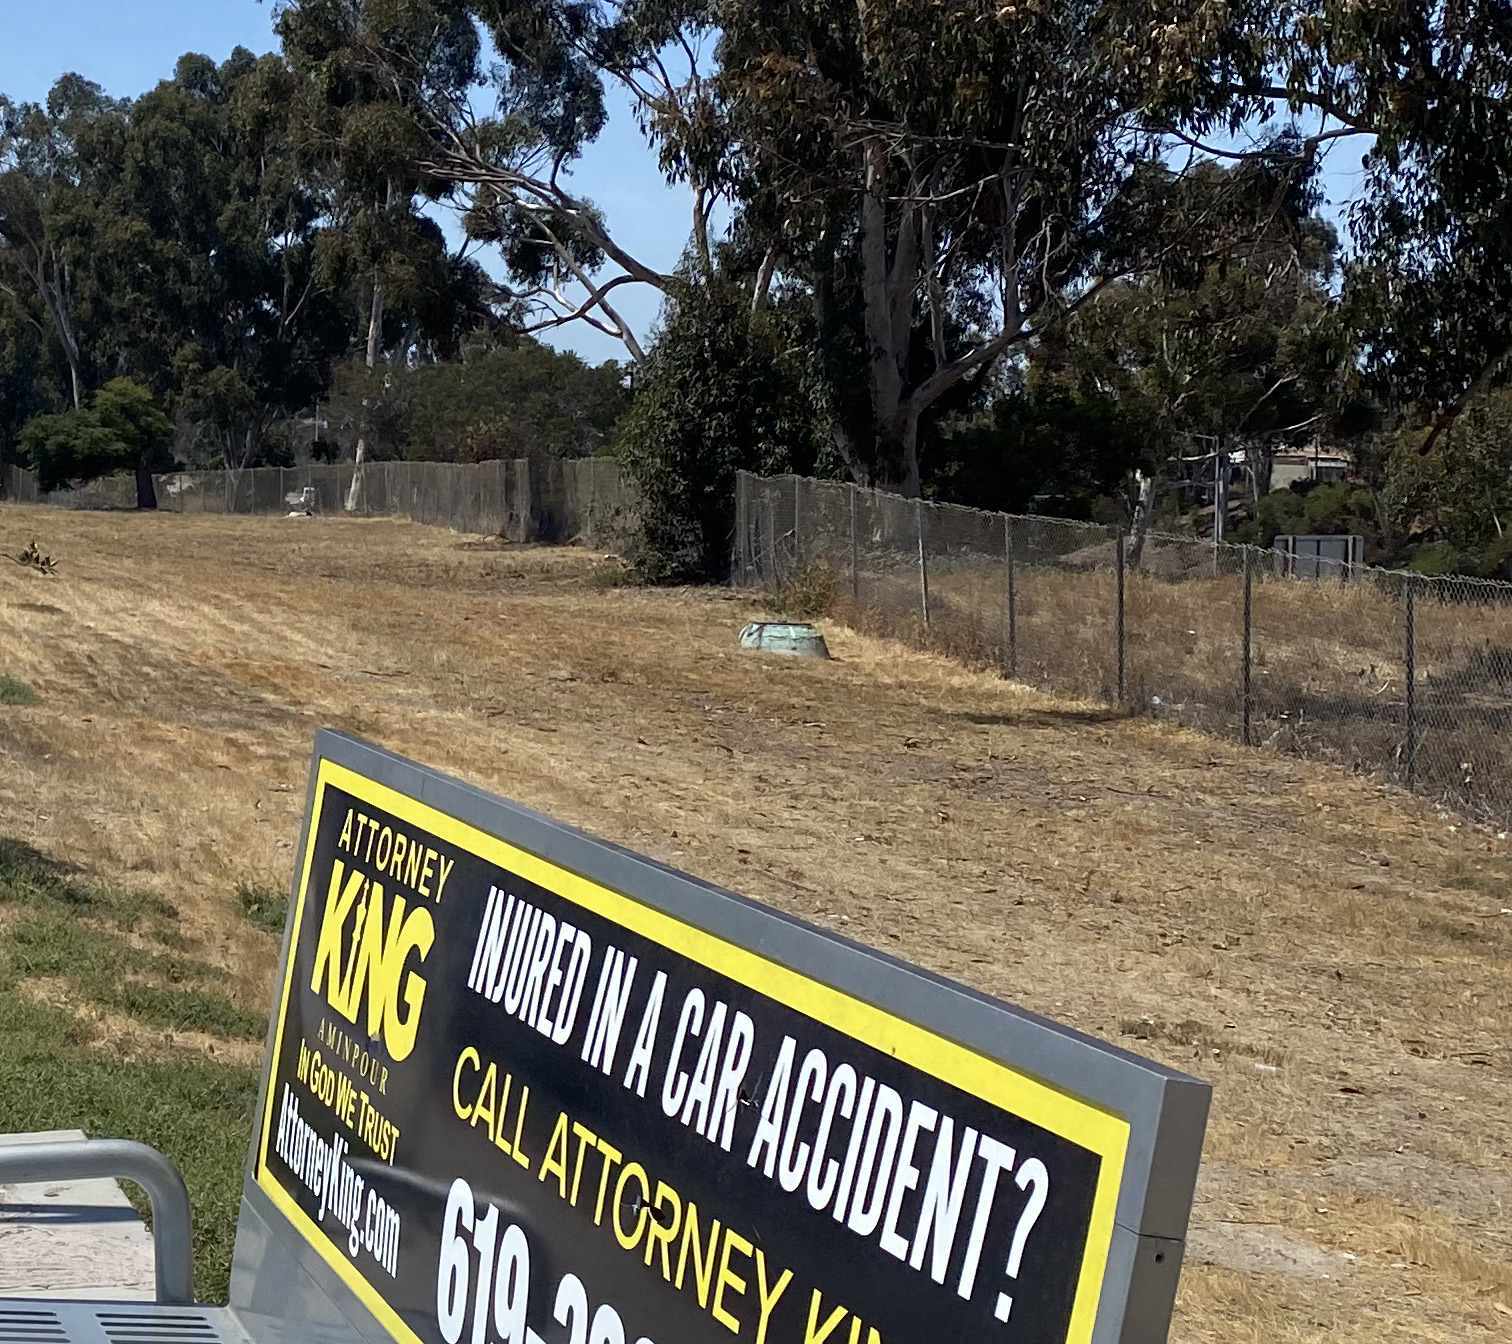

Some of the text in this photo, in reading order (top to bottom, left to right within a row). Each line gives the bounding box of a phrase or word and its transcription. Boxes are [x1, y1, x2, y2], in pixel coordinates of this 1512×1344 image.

[338, 808, 455, 904] ATTORNEY
[310, 858, 435, 1062] KING
[317, 1016, 389, 1096] AMINPOUR
[452, 1046, 530, 1170] CALL
[467, 885, 1049, 1323] INJURED IN A CAR ACCIDENT?
[275, 1081, 401, 1279] AttorneyKing.com
